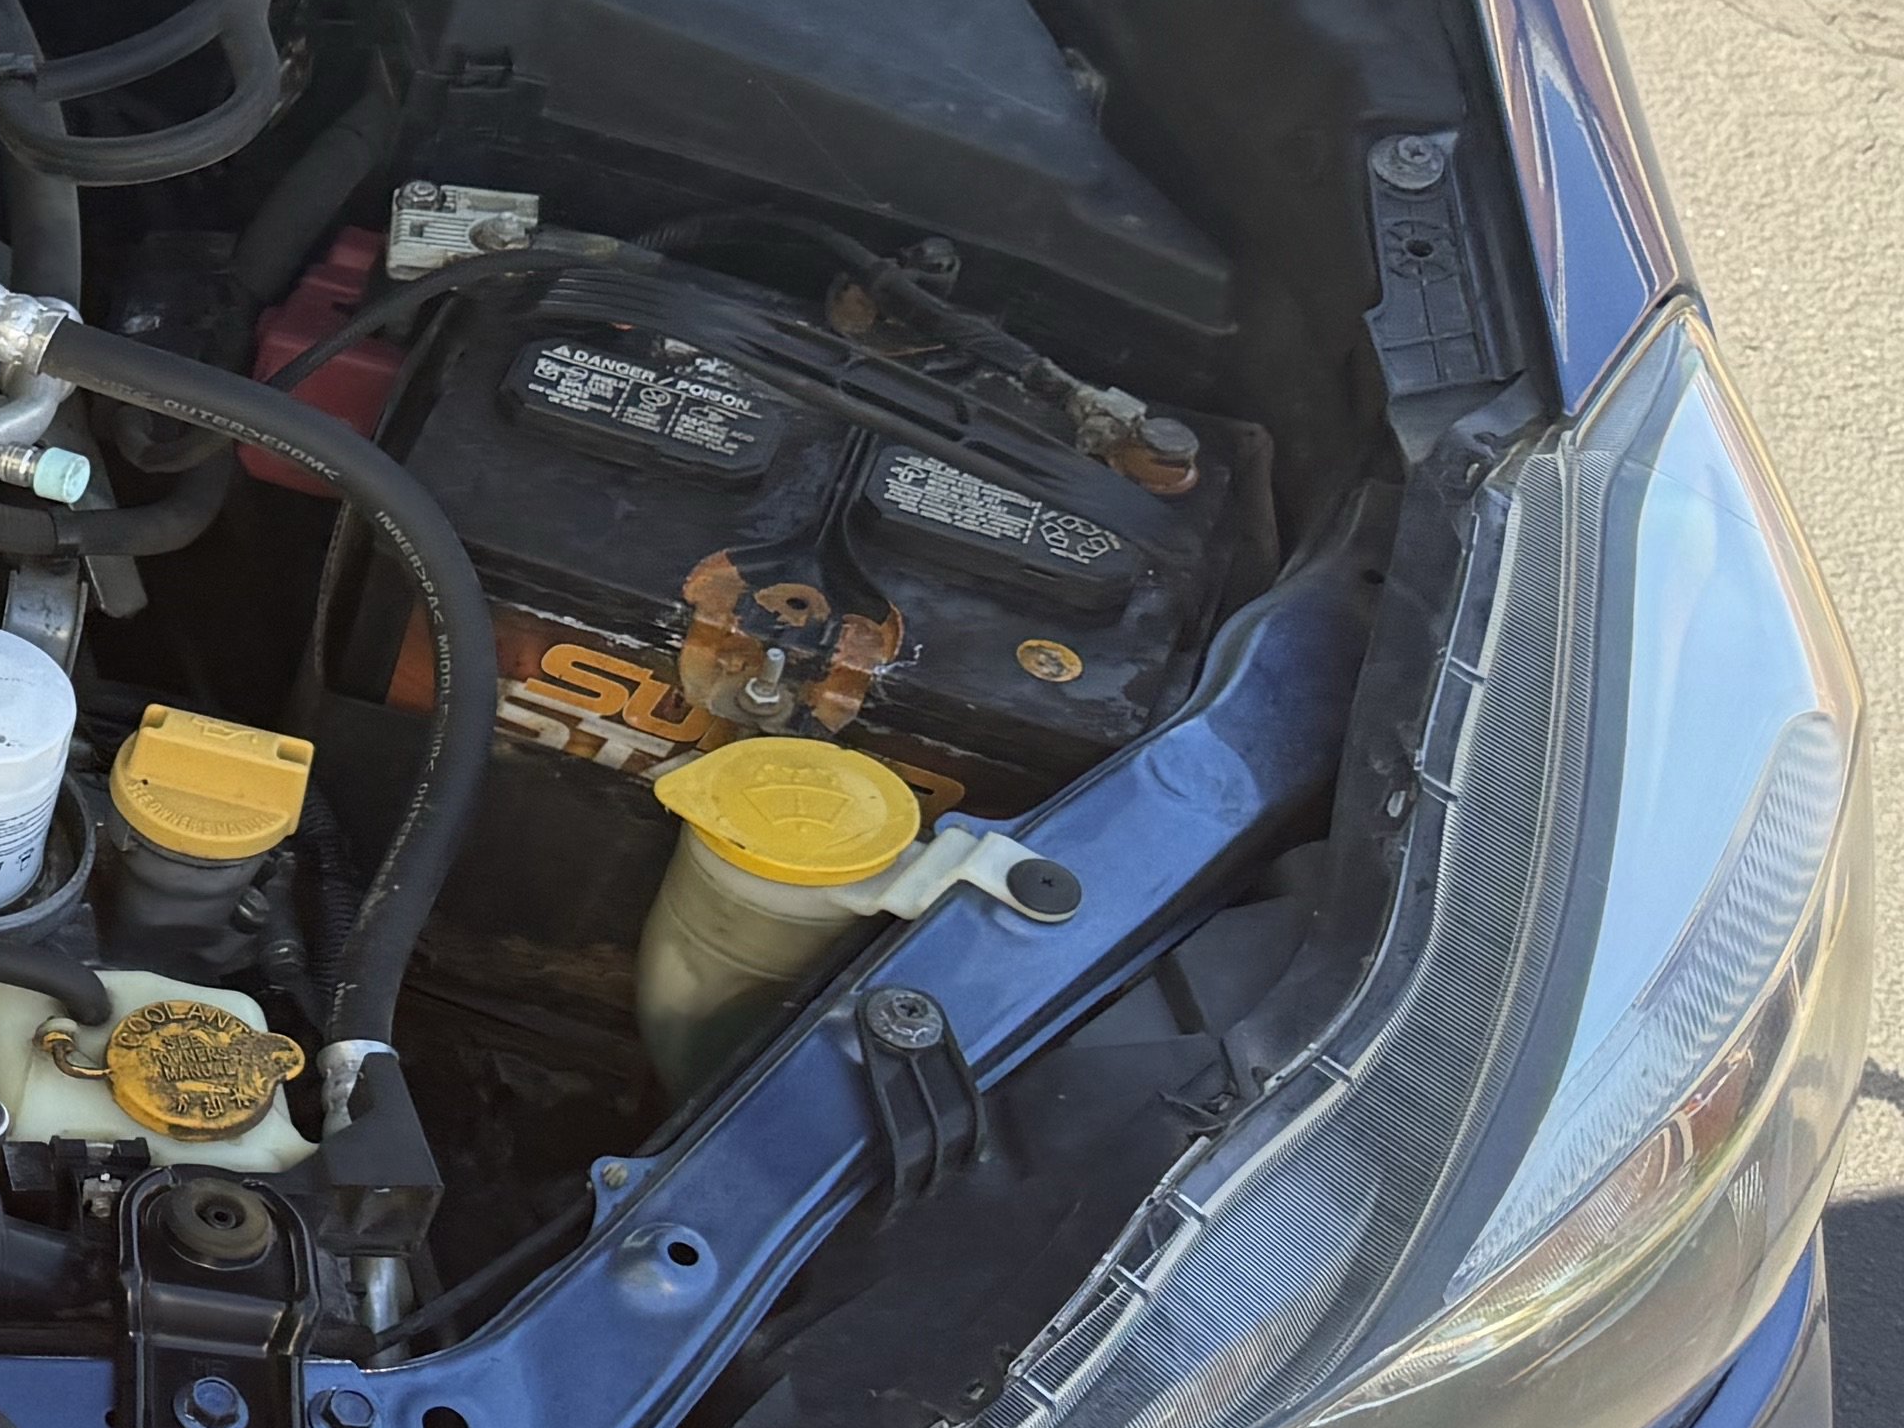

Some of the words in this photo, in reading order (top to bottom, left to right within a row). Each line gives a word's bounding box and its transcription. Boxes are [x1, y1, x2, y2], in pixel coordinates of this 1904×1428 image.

[573, 349, 657, 383] DANGER
[676, 379, 752, 412] POISON
[117, 1002, 252, 1048] COOLANT
